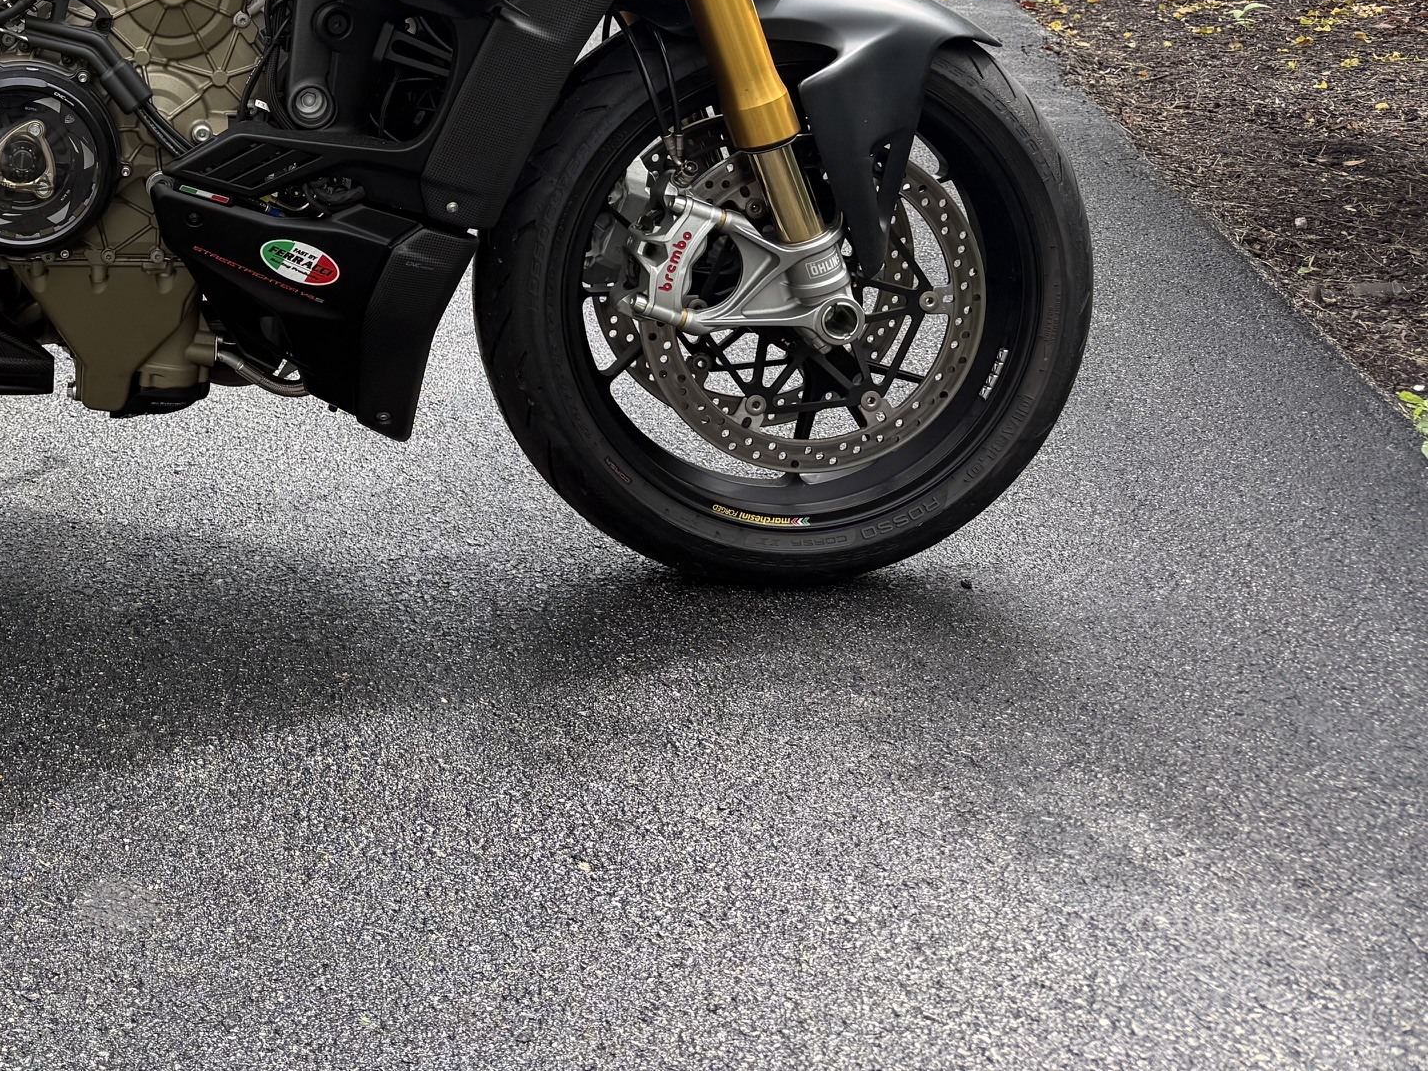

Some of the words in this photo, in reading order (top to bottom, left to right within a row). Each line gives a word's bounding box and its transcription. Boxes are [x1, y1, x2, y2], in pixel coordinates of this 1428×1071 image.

[268, 246, 333, 277] FERRACCI
[293, 248, 308, 257] FAST
[658, 231, 692, 292] brembo
[809, 253, 840, 276] ÖHLINS
[712, 503, 737, 515] FORGED
[738, 511, 790, 524] marchesini
[858, 495, 942, 541] ROSSO
[790, 532, 848, 547] CORSA
